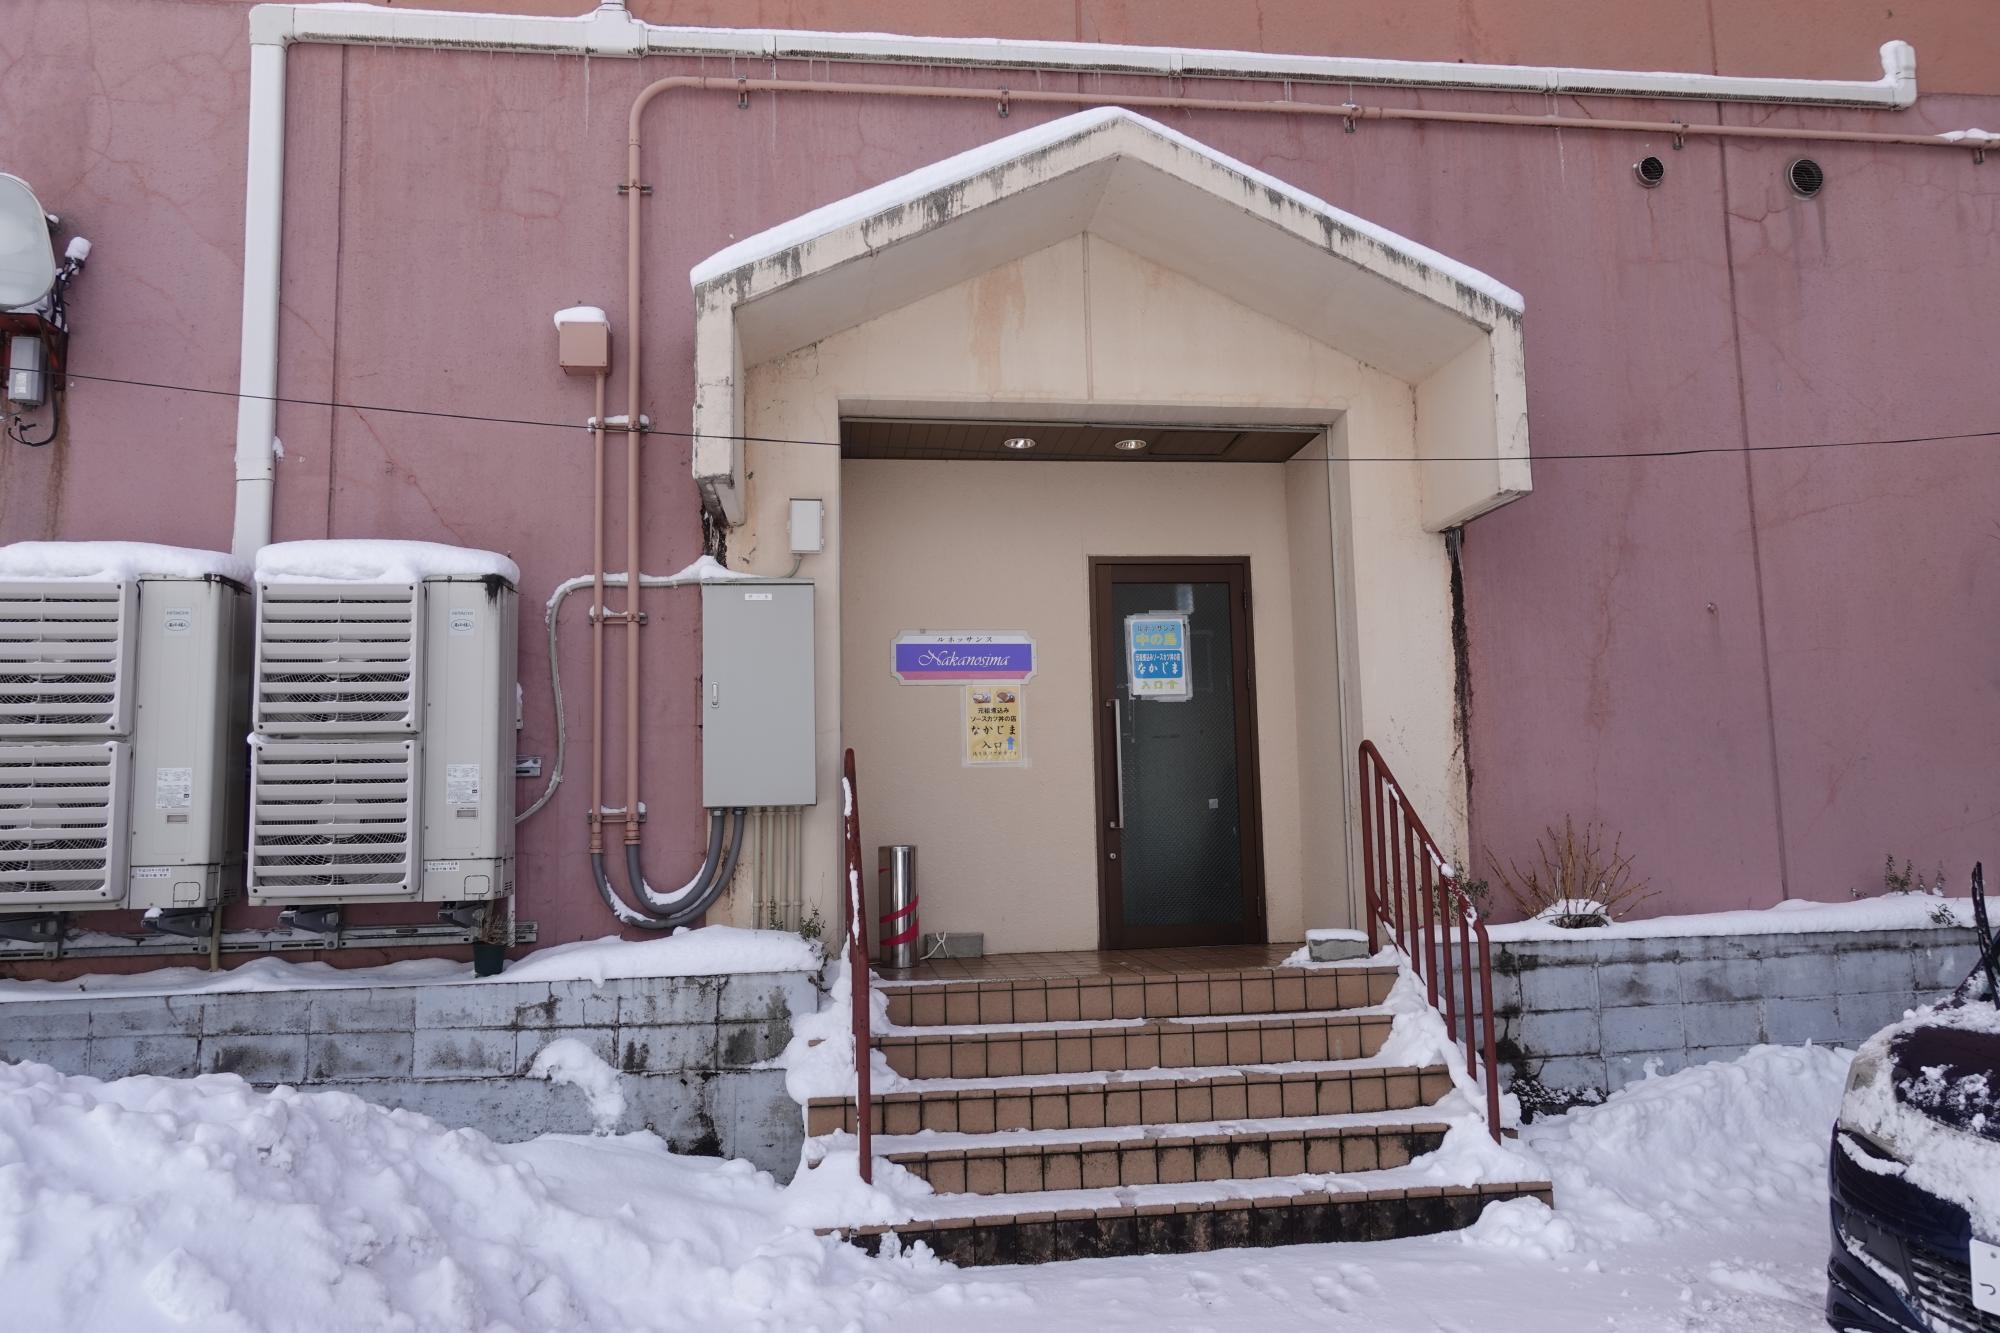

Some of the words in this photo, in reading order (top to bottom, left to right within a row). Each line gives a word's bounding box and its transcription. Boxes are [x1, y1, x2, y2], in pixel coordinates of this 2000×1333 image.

[936, 635, 993, 643] ルネッサンス
[918, 649, 1011, 668] Nakanosima
[1138, 662, 1178, 675] なかじま
[1141, 681, 1163, 689] 入口
[972, 725, 1016, 735] なかじま
[982, 740, 1002, 749] 入口
